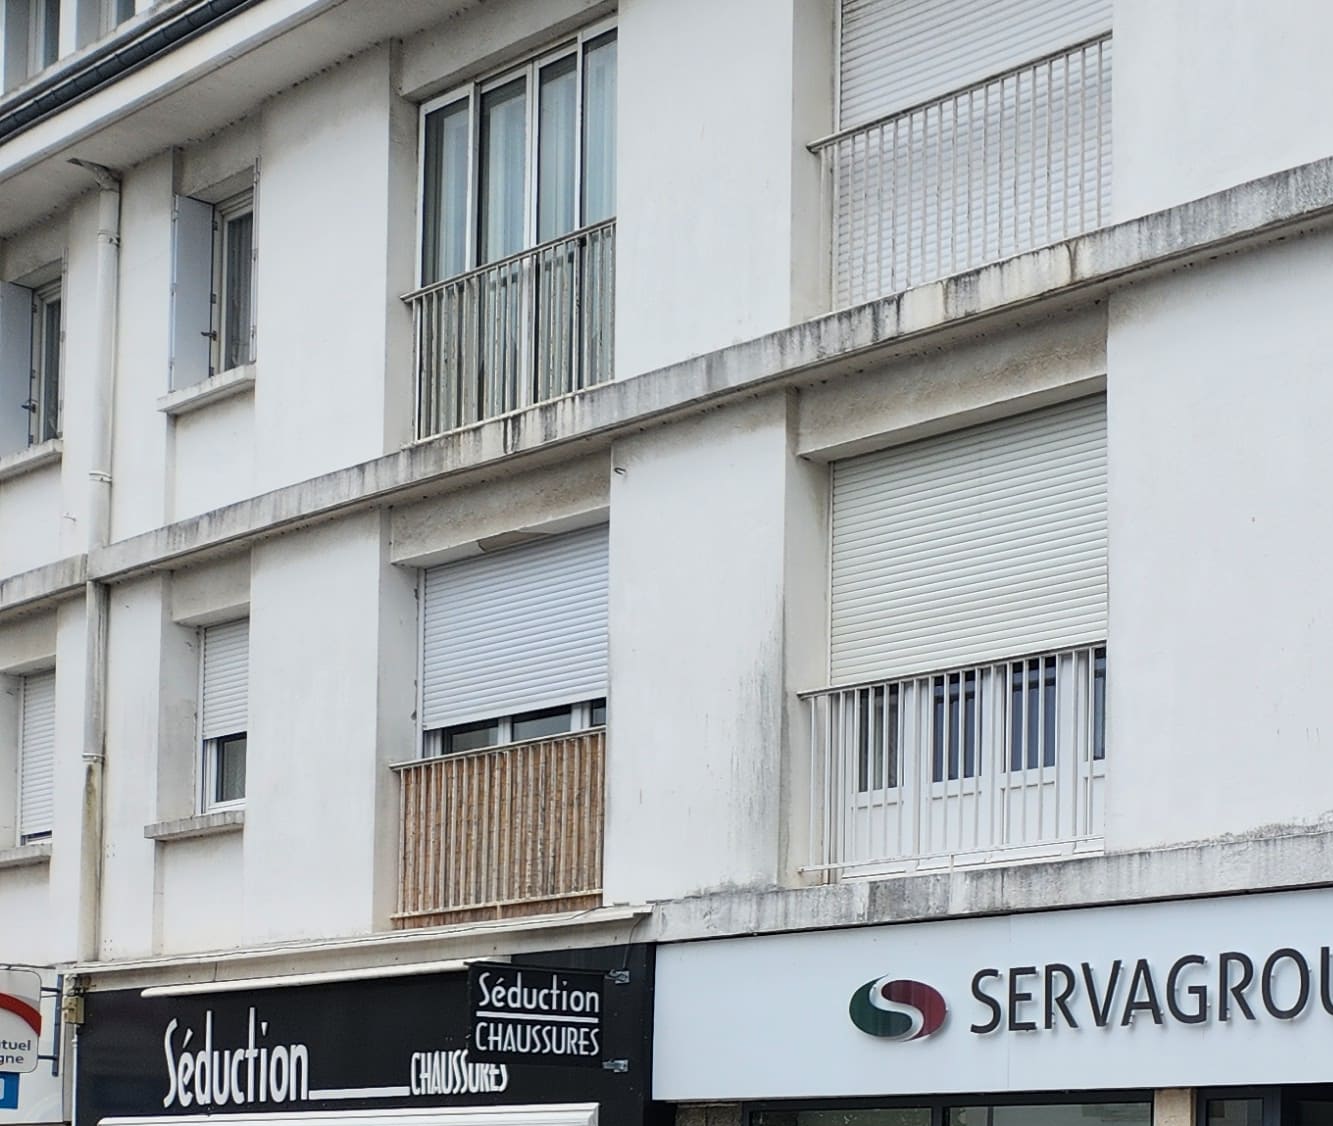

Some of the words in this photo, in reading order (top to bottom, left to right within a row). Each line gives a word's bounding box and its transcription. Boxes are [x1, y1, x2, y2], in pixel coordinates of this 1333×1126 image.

[478, 971, 600, 1013] Séduction
[163, 1006, 309, 1108] Séduction
[475, 1021, 600, 1056] CHAUSSURES
[410, 1048, 508, 1095] CHAUSSURES
